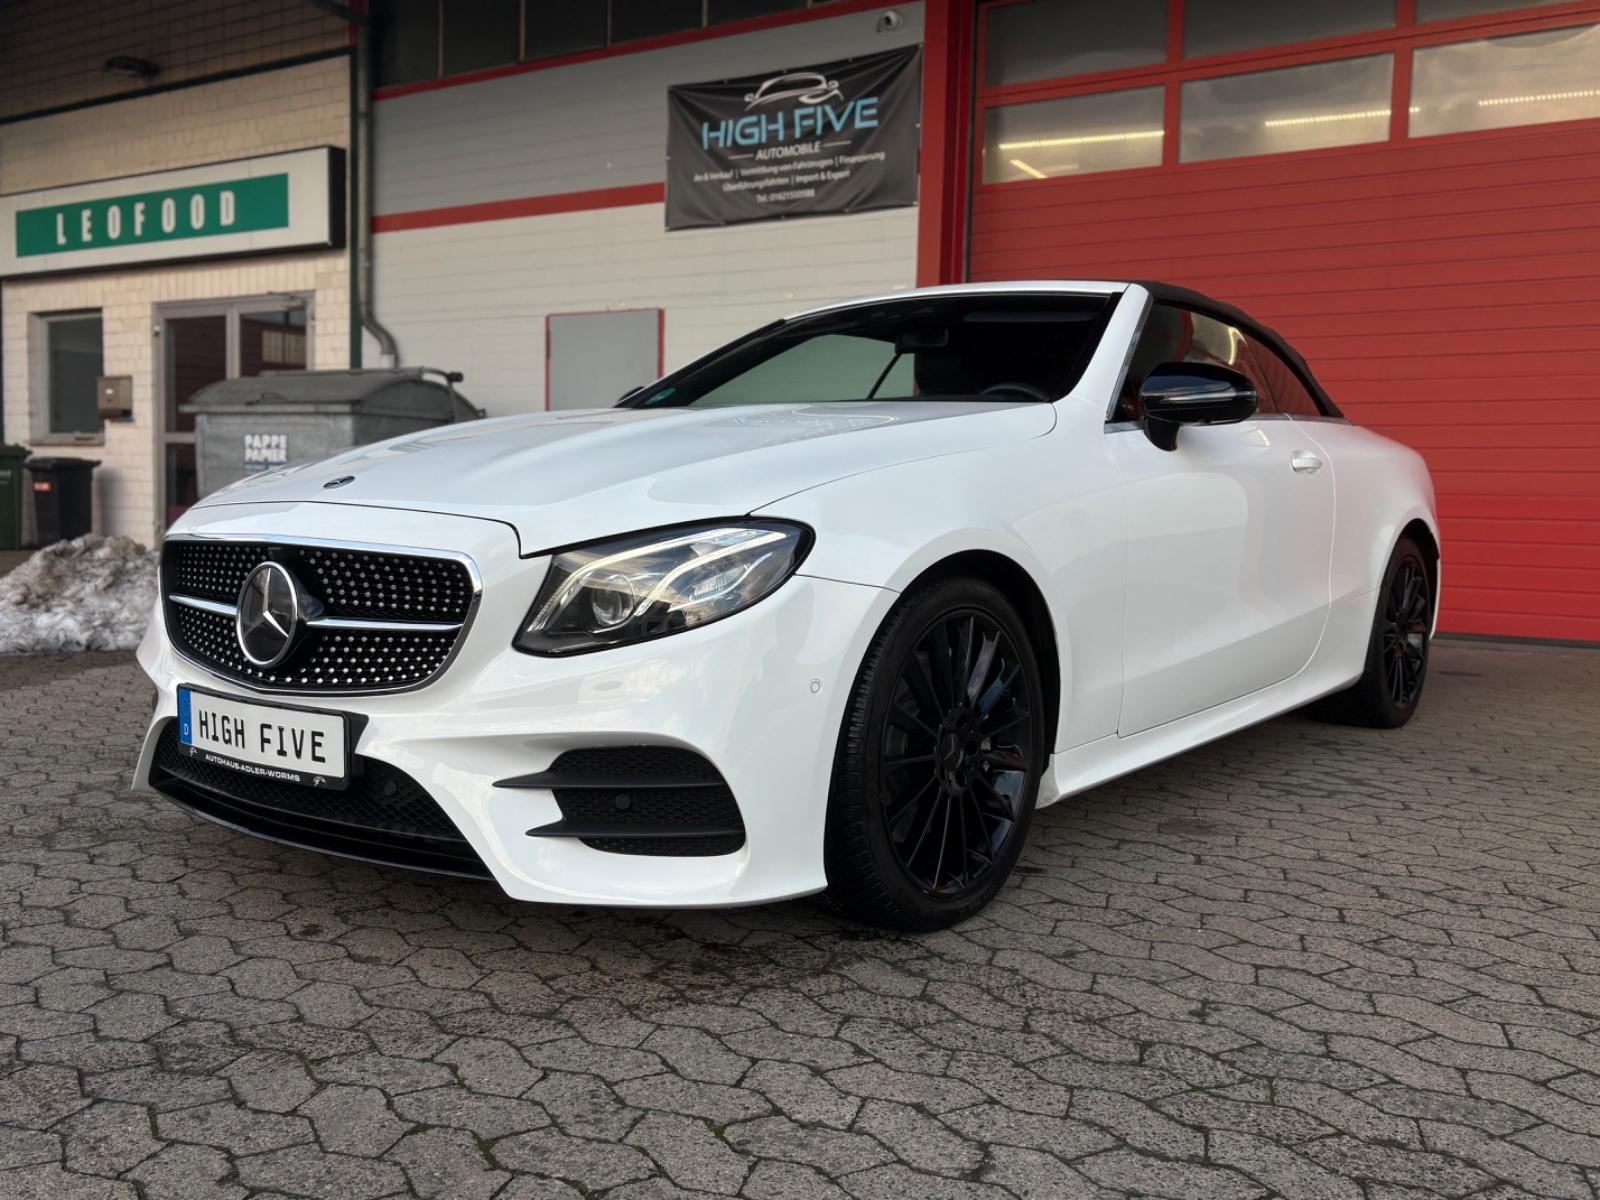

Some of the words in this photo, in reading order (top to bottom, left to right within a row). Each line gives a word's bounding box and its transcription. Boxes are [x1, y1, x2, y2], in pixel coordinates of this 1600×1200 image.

[702, 112, 784, 149] HIGH
[794, 97, 879, 139] FIVE
[755, 141, 821, 160] AUTOMOBILE
[57, 191, 235, 245] LEOFOOD
[244, 434, 287, 448] PAPPE
[184, 723, 188, 736] D
[199, 710, 246, 749] HIGH
[260, 723, 326, 763] FIVE
[205, 754, 300, 782] AUTOHAUS-ADLER-WORMS
